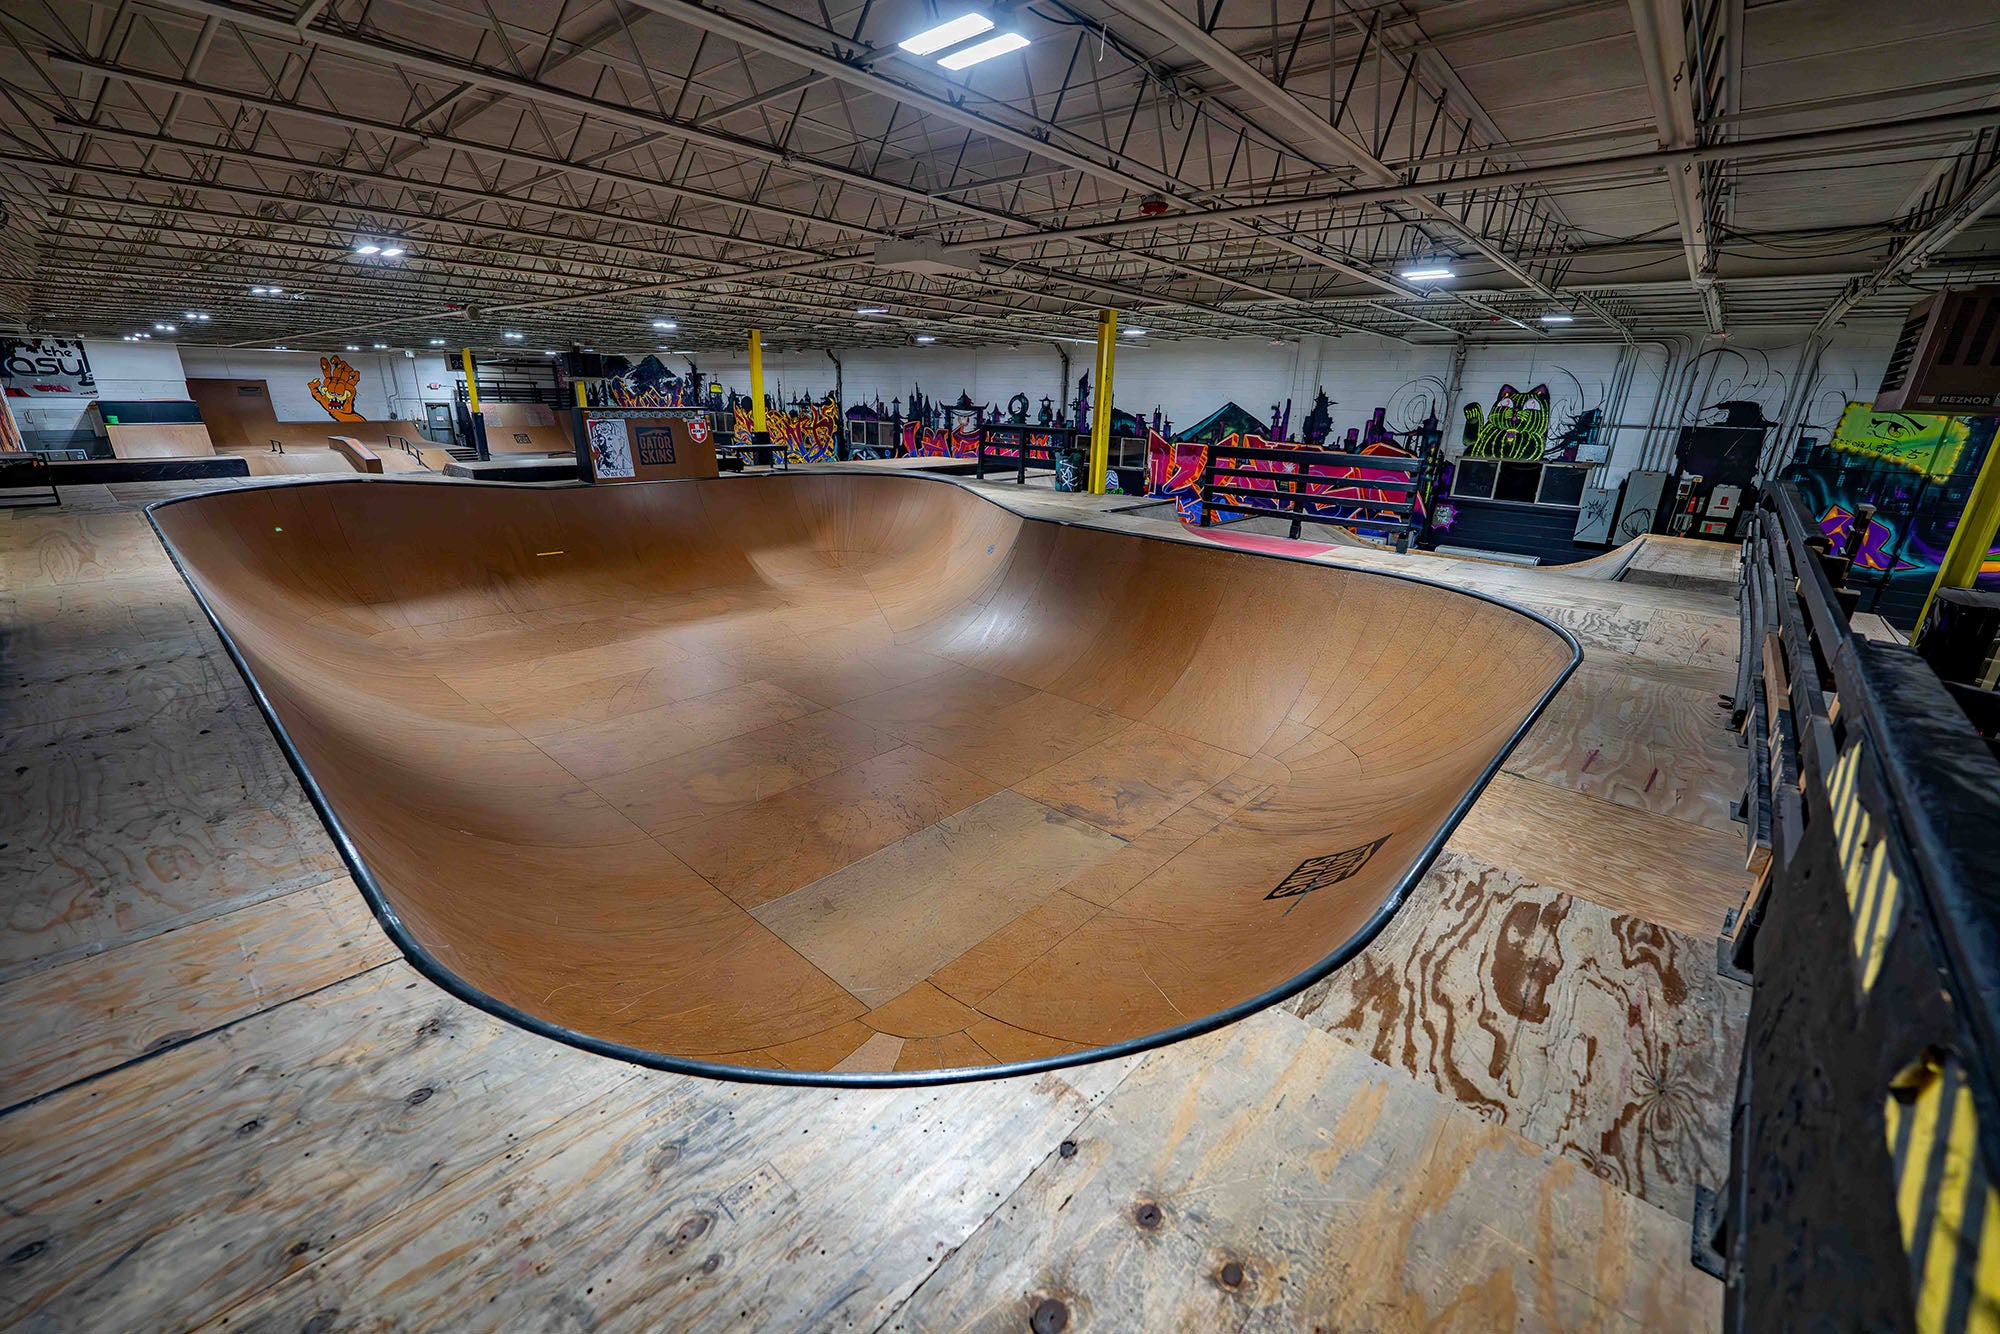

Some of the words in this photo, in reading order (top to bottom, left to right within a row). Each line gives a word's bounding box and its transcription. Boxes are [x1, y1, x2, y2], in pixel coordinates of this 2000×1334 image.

[42, 345, 72, 357] the
[1940, 396, 1991, 405] REZNOR
[640, 436, 672, 449] GATOR
[642, 449, 674, 463] SKINS
